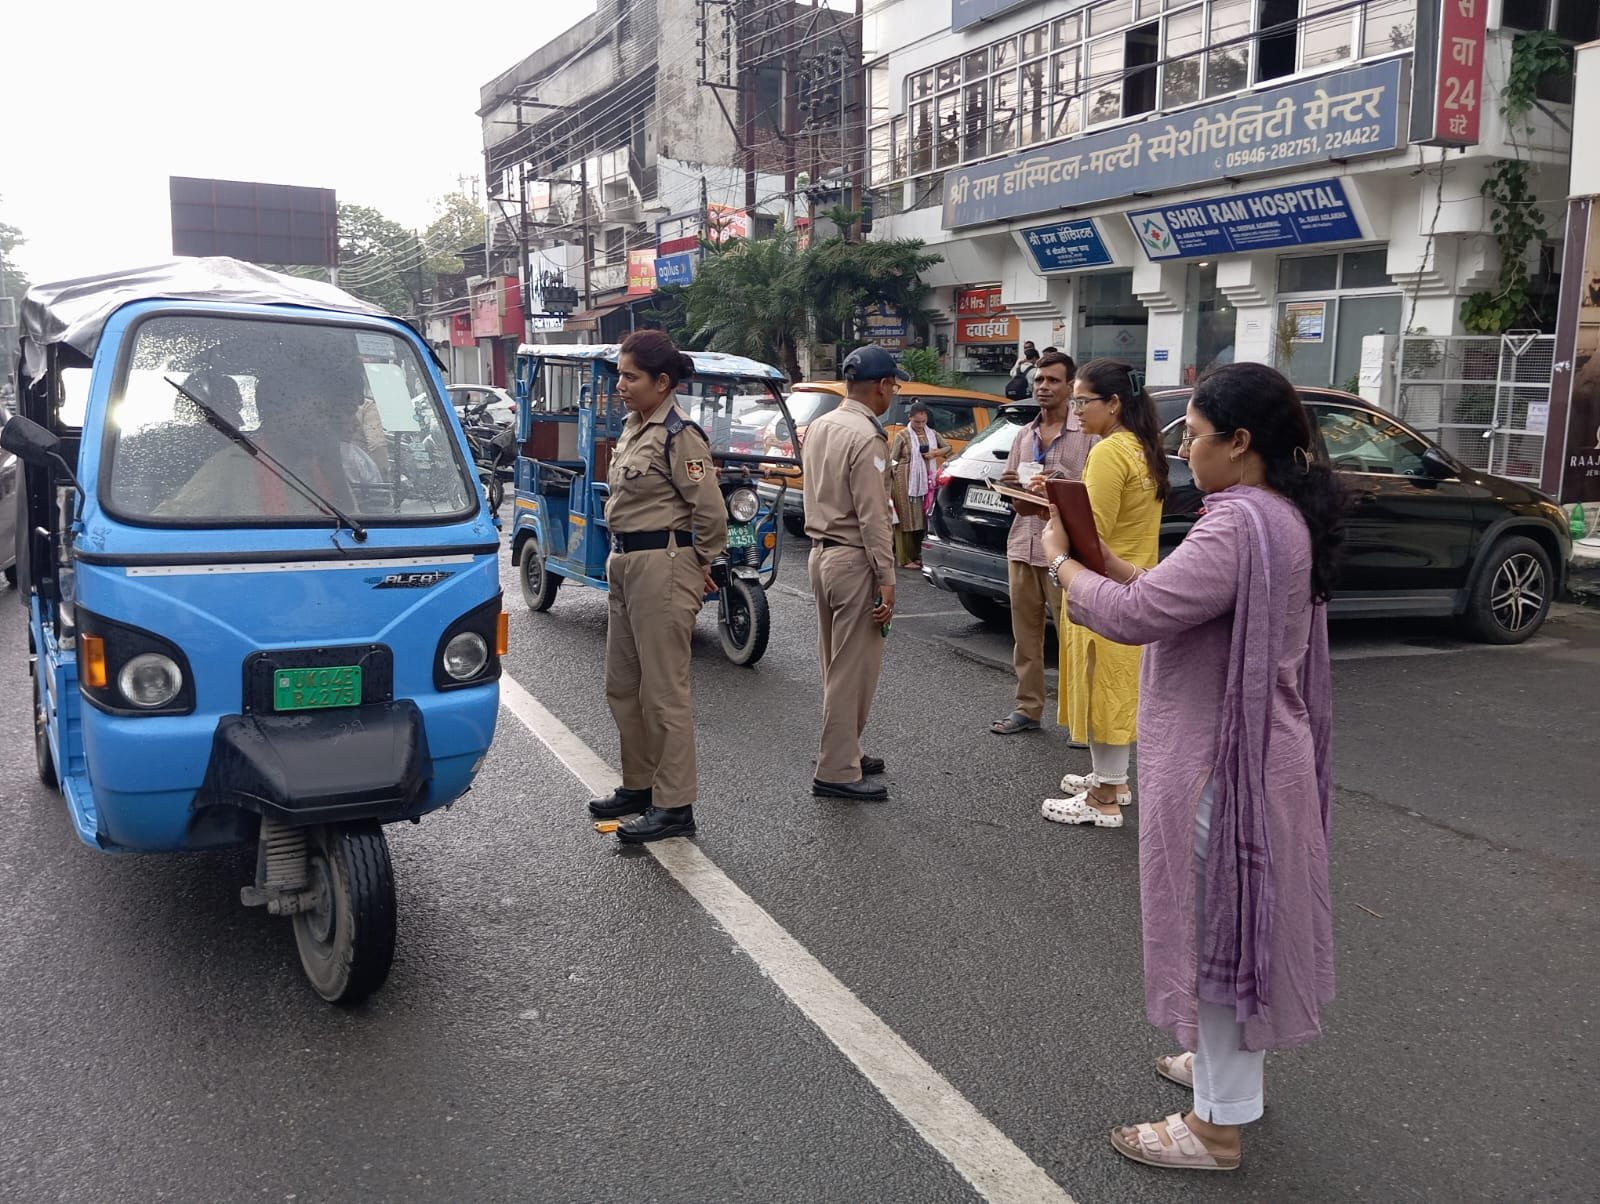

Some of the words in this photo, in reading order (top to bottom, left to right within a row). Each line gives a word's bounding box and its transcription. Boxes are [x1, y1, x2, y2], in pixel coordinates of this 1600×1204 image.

[1444, 77, 1476, 111] 24
[950, 175, 969, 205] श्री
[972, 175, 1000, 200] राम
[1302, 86, 1386, 130] सेन्टर
[1324, 125, 1380, 151] 224422
[1166, 207, 1208, 230] SHRI
[1206, 200, 1250, 223] RAM
[1247, 186, 1344, 219] HOSPITAL
[970, 296, 985, 309] Hrs.
[293, 668, 353, 689] UK04E
